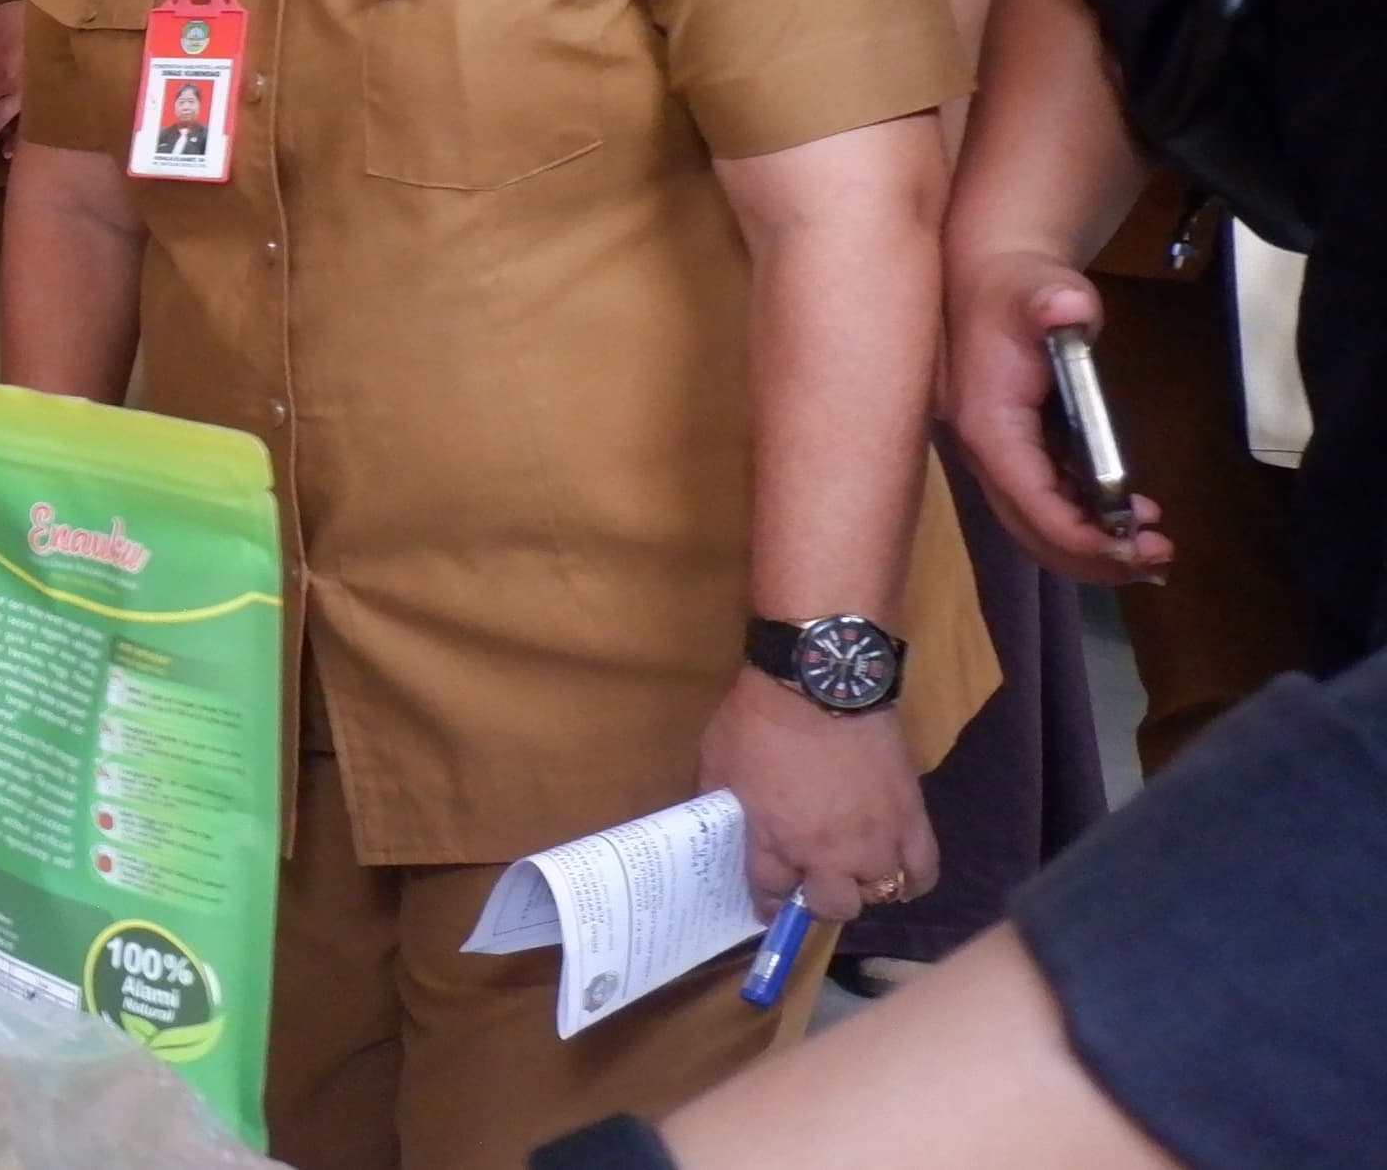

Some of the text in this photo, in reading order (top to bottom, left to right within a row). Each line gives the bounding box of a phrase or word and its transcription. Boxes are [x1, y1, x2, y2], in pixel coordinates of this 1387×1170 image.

[28, 501, 152, 574] Enauku
[106, 937, 194, 986] 100%
[122, 975, 181, 1009] Alami
[122, 996, 176, 1023] Natural
